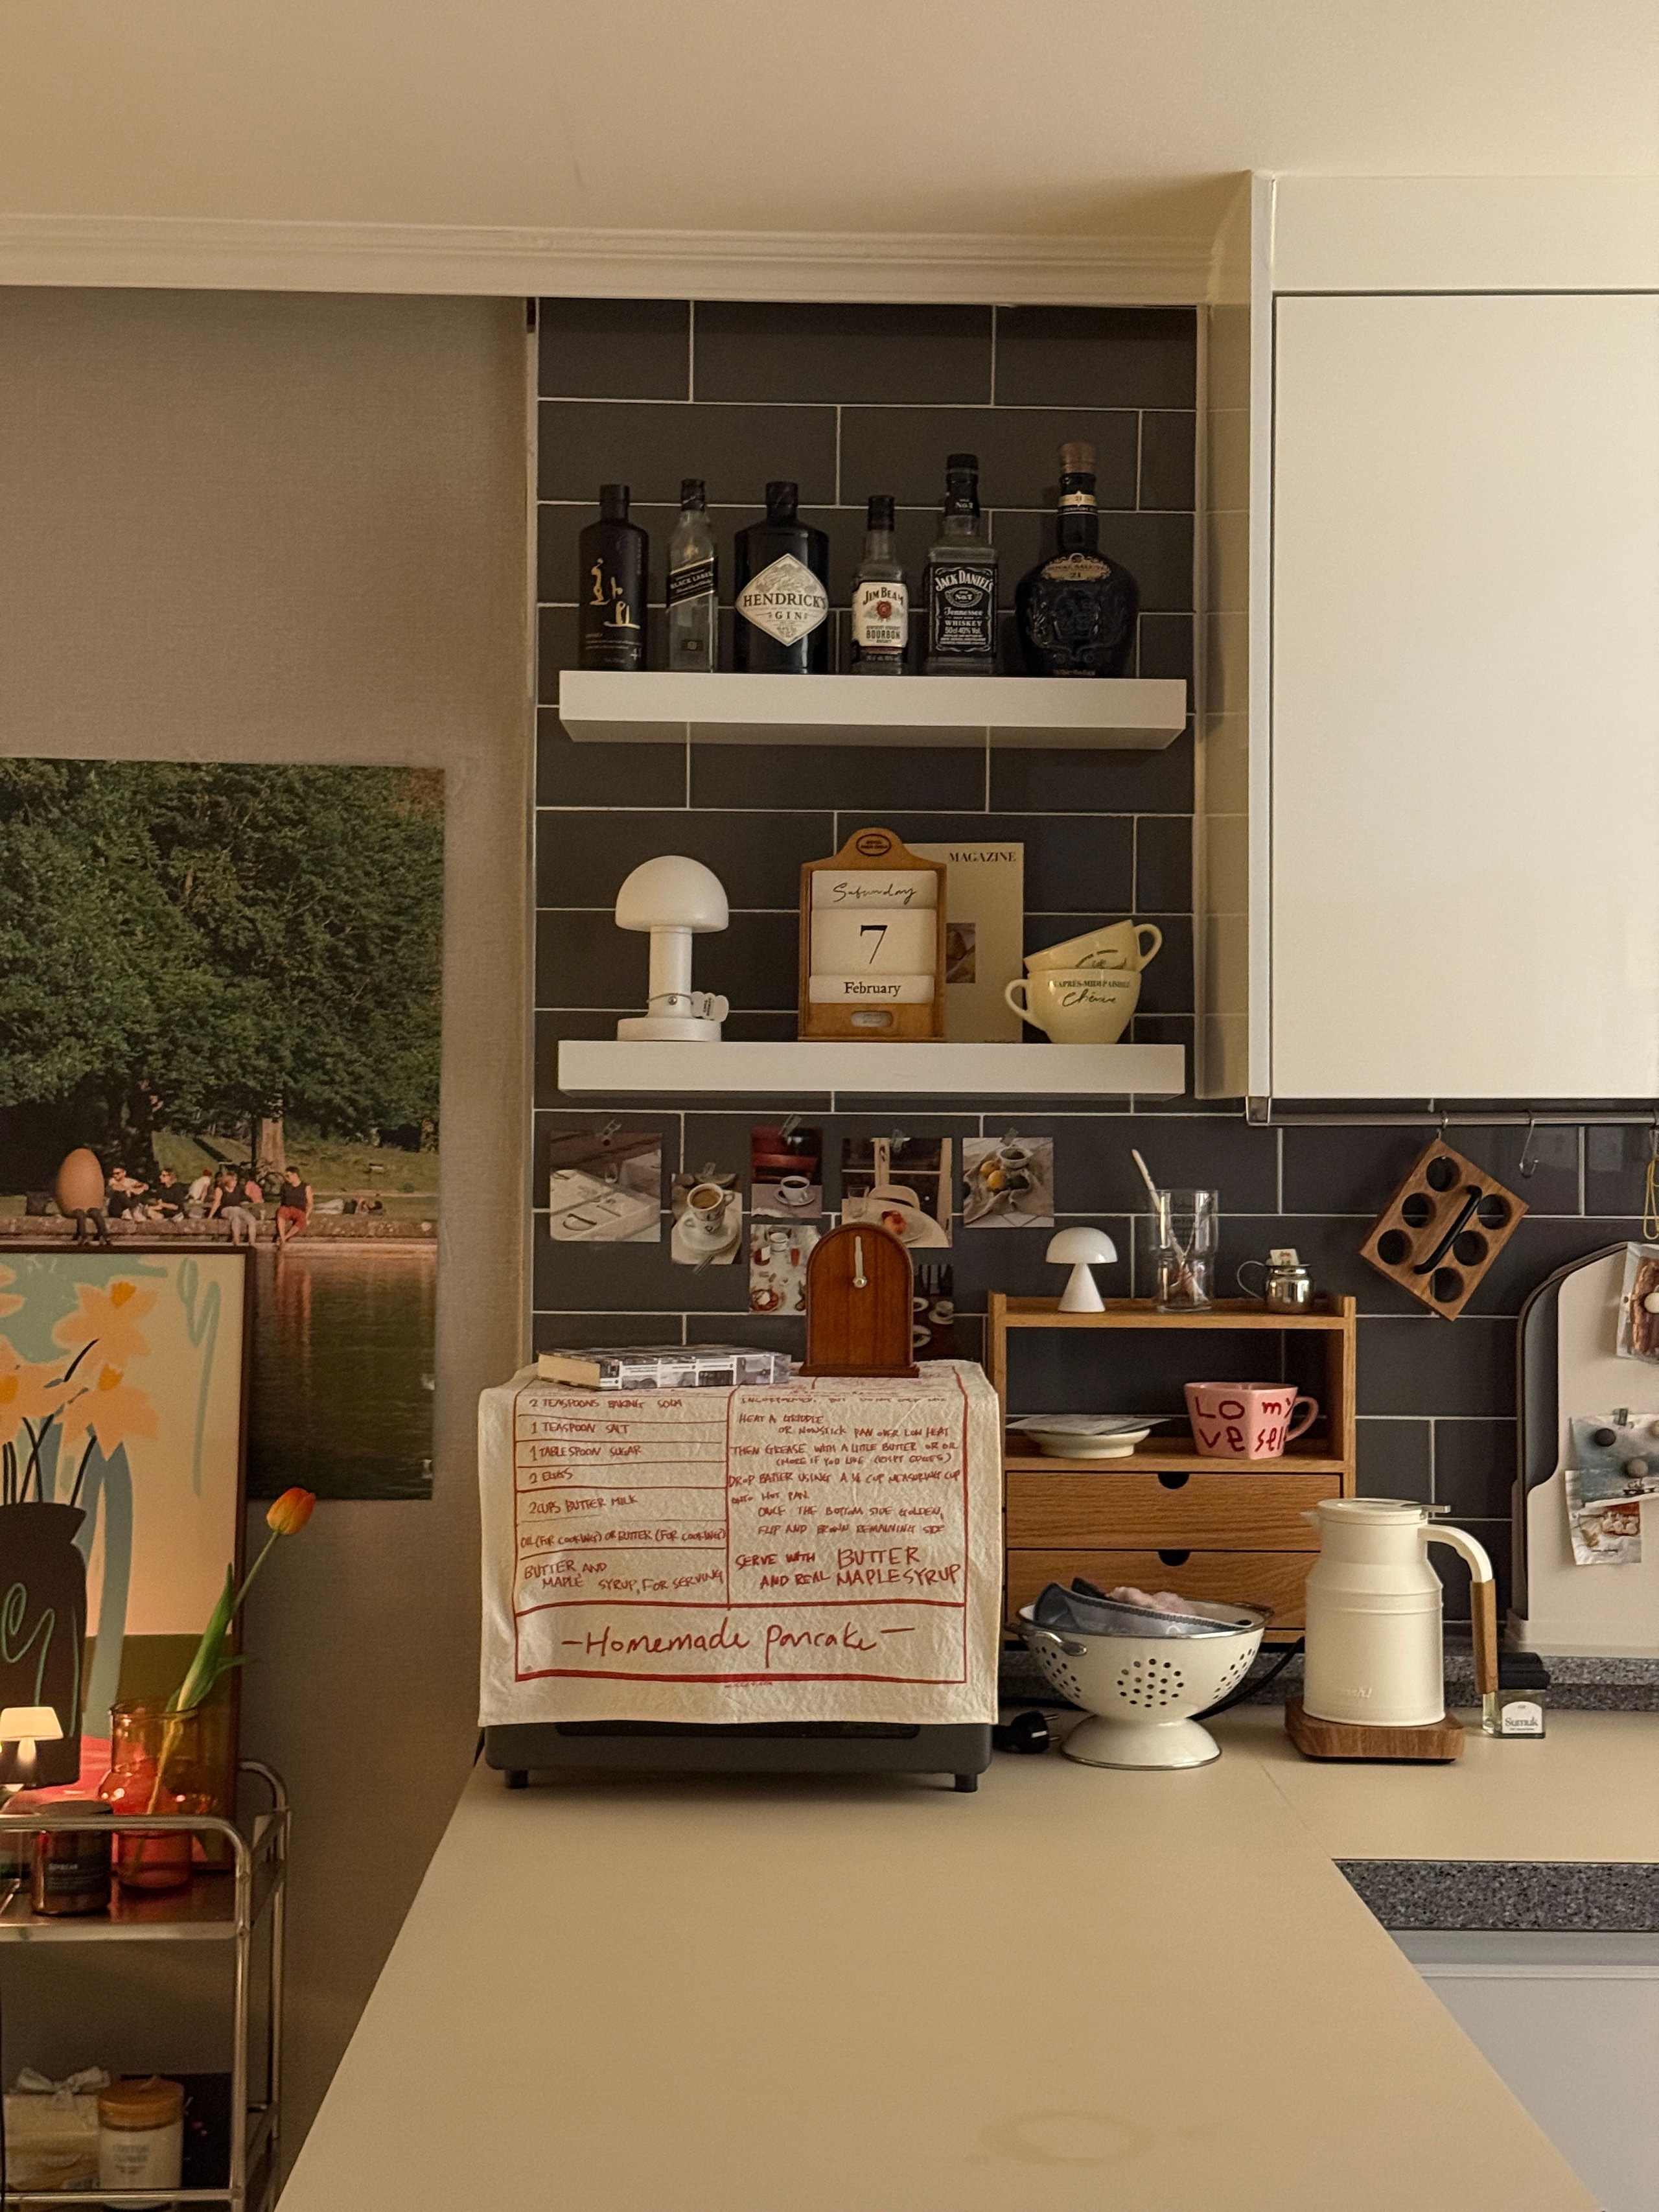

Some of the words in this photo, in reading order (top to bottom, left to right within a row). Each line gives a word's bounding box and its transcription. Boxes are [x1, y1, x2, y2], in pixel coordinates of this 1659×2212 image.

[934, 573, 958, 592] JACK
[958, 570, 994, 593] DANIEL'S
[743, 592, 827, 610] HENDRICK'S
[863, 590, 880, 605] JIM
[880, 587, 904, 607] BEAM
[775, 611, 804, 620] GIN
[944, 607, 983, 616] Tennessee
[866, 630, 901, 640] BOURBON
[949, 852, 1017, 863] MAGAZINE
[832, 881, 917, 905] Saturday
[859, 924, 888, 965] 7
[843, 981, 901, 997] February
[529, 1399, 538, 1408] 2
[542, 1399, 599, 1408] TEASPOONS
[608, 1400, 645, 1408] BAKING
[657, 1399, 682, 1408] SODA
[738, 1412, 765, 1424] HEAT
[769, 1414, 777, 1423] A
[783, 1414, 824, 1424] GRIDDLE
[531, 1421, 537, 1434] 1
[543, 1422, 596, 1433] TEASPOON
[606, 1424, 630, 1434] SALT
[778, 1425, 793, 1434] OR
[798, 1425, 847, 1435] NONSTICK
[853, 1428, 874, 1438] PAN
[876, 1428, 899, 1438] OVER
[904, 1428, 923, 1437] LOW
[925, 1426, 949, 1438] HEAT
[530, 1446, 537, 1460] 1
[610, 1445, 642, 1456] SUGAR
[730, 1445, 760, 1456] THEN
[765, 1443, 808, 1455] GREASE
[814, 1443, 836, 1453] WITH
[841, 1443, 849, 1452] A
[851, 1443, 877, 1453] LITTLE
[882, 1441, 917, 1452] BUTTER
[925, 1441, 939, 1450] OR
[810, 1455, 820, 1465] IF
[824, 1457, 841, 1466] YOU
[845, 1456, 864, 1465] LIKE
[530, 1473, 538, 1484] 2
[542, 1467, 574, 1482] EGGS
[728, 1474, 755, 1489] DROP
[759, 1472, 793, 1484] BATTER
[798, 1472, 831, 1484] USING
[839, 1472, 848, 1482] A
[866, 1473, 885, 1484] CUP
[888, 1470, 942, 1484] MEASURING
[944, 1469, 961, 1482] CUP
[566, 1498, 607, 1511] BUTTER
[611, 1495, 638, 1506] MILK
[731, 1494, 754, 1504] ONTO
[761, 1491, 780, 1501] HOT
[758, 1504, 786, 1517] ONCE
[797, 1505, 818, 1515] THE
[826, 1506, 864, 1517] BOTTOM
[869, 1506, 892, 1516] SIDE
[604, 1530, 616, 1541] OR
[618, 1530, 653, 1542] BUTTER
[758, 1524, 781, 1535] FLIP
[785, 1523, 808, 1534] AND
[817, 1523, 850, 1535] BROWN
[856, 1523, 916, 1534] REMAINING
[922, 1524, 945, 1535] SIDE
[735, 1553, 778, 1571] SERVE
[785, 1550, 816, 1563] WITH
[837, 1546, 921, 1570] BUTTER
[582, 1562, 608, 1574] AND
[542, 1575, 583, 1589] MAPLE
[642, 1578, 669, 1592] FOR
[672, 1568, 724, 1589] SERVING
[760, 1575, 790, 1590] AND
[795, 1570, 831, 1586] REAL
[836, 1568, 901, 1587] MAPLE
[903, 1563, 961, 1587] SYRUP
[585, 1616, 750, 1657] Homemade
[1505, 1716, 1539, 1727] Sumuk
